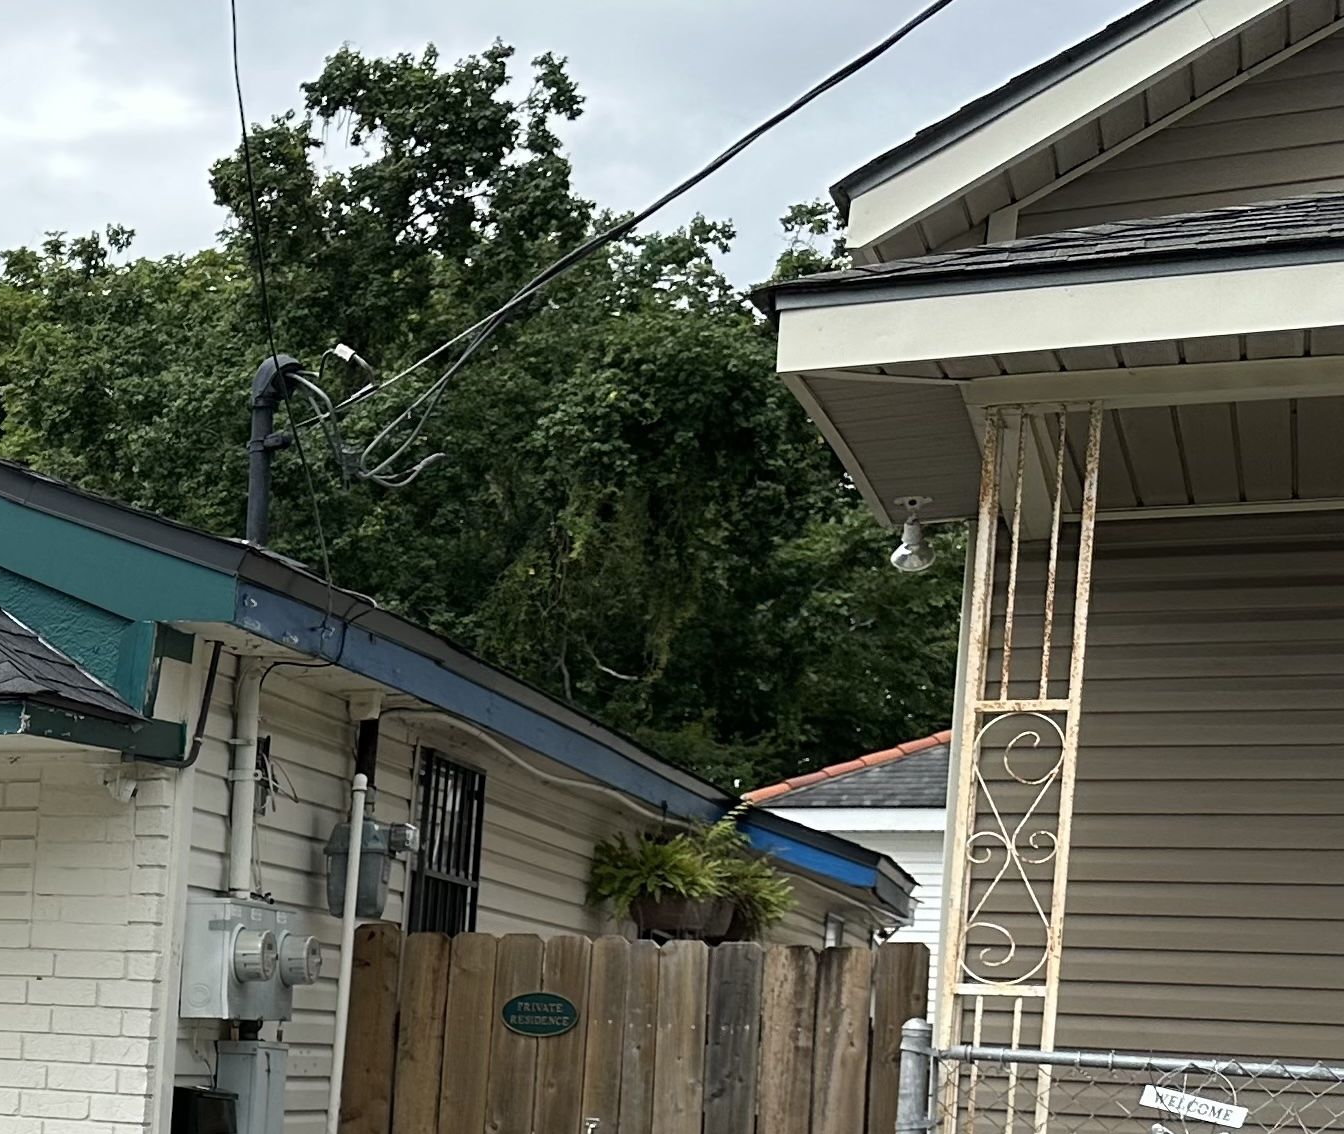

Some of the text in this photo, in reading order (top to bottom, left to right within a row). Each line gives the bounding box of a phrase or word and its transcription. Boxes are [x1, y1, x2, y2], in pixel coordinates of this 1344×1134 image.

[516, 1001, 564, 1013] PRIVATE
[510, 1014, 570, 1027] RESIDENCE
[1154, 1091, 1234, 1122] WELCOME
